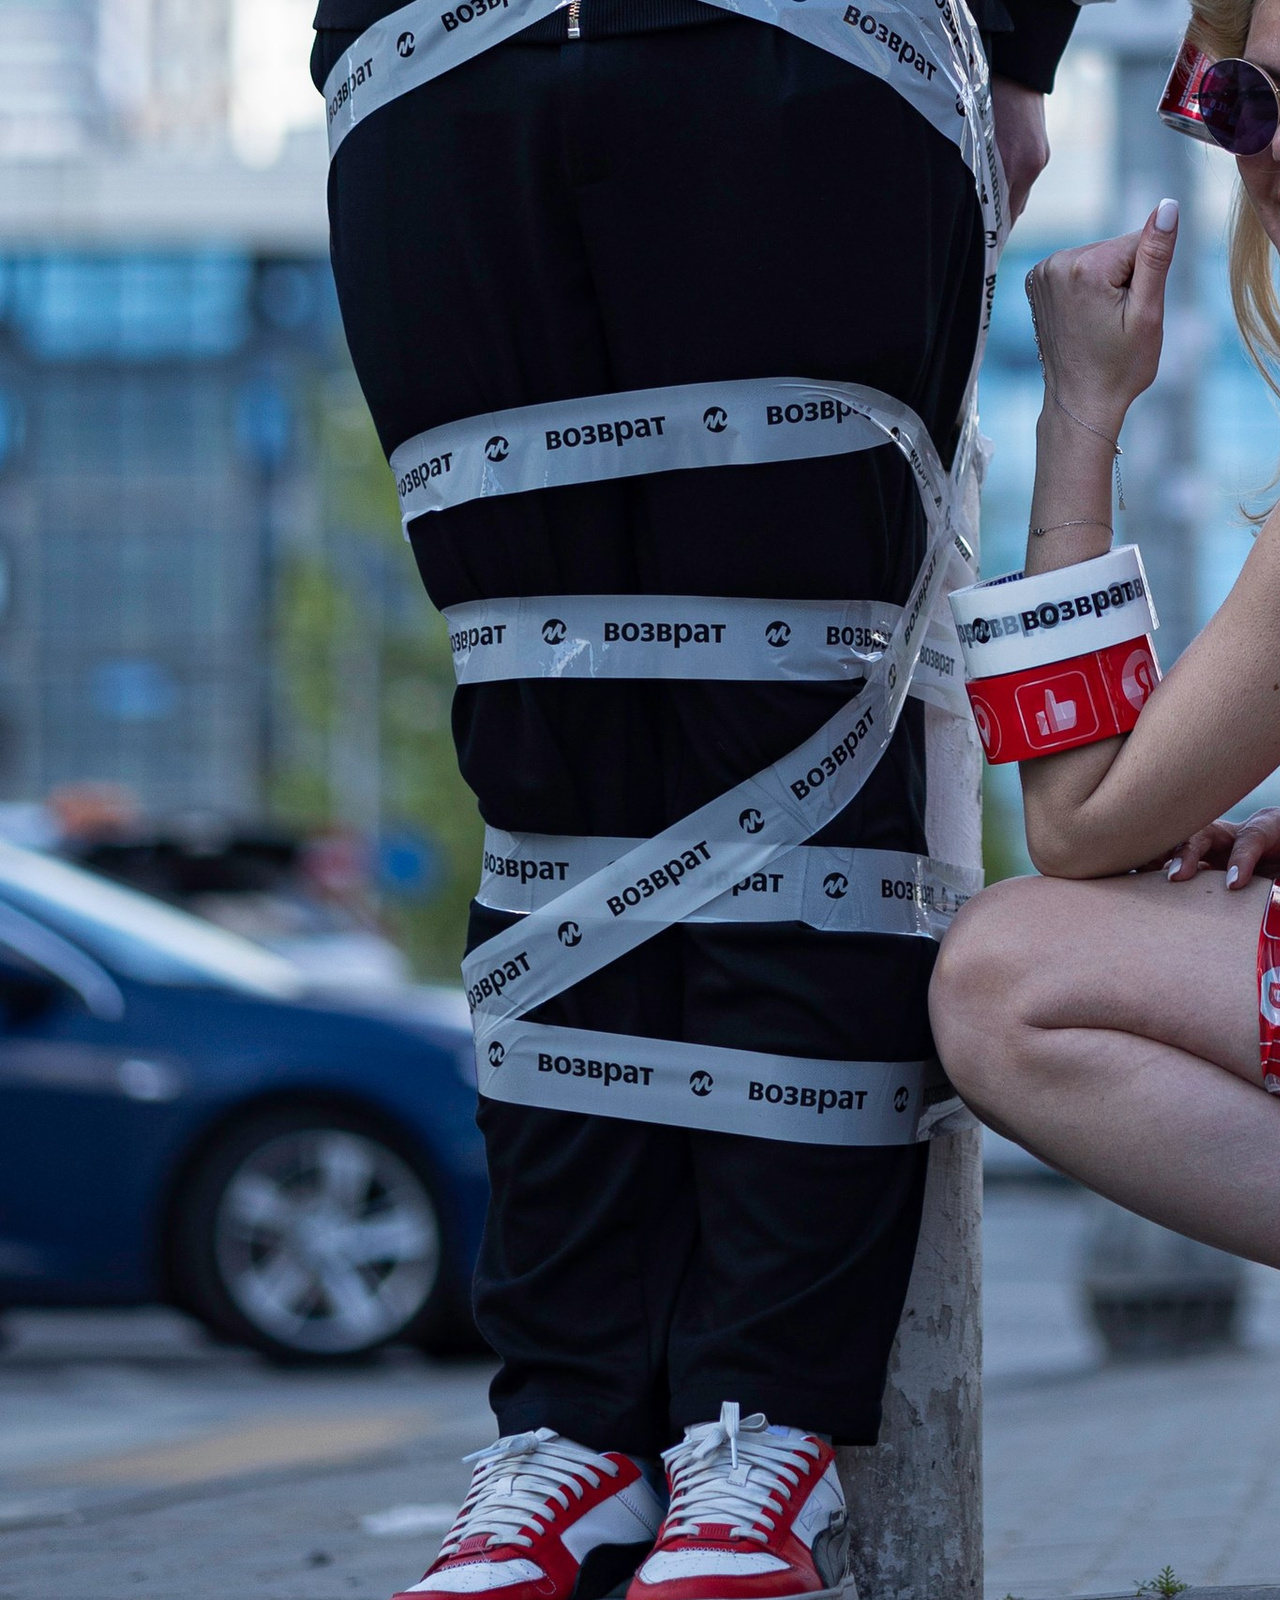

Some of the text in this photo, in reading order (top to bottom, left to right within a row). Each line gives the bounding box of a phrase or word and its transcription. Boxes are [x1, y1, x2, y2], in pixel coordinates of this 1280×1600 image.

[843, 4, 938, 82] возврат
[545, 414, 666, 452] возврат
[1021, 582, 1133, 632] возврат
[603, 620, 726, 649] возврат
[919, 645, 955, 678] возврат
[606, 839, 713, 918] возврат
[790, 706, 877, 801] возврат
[904, 550, 938, 647] возврат
[483, 850, 570, 884] возврат
[537, 1051, 868, 1114] возврат возврат
